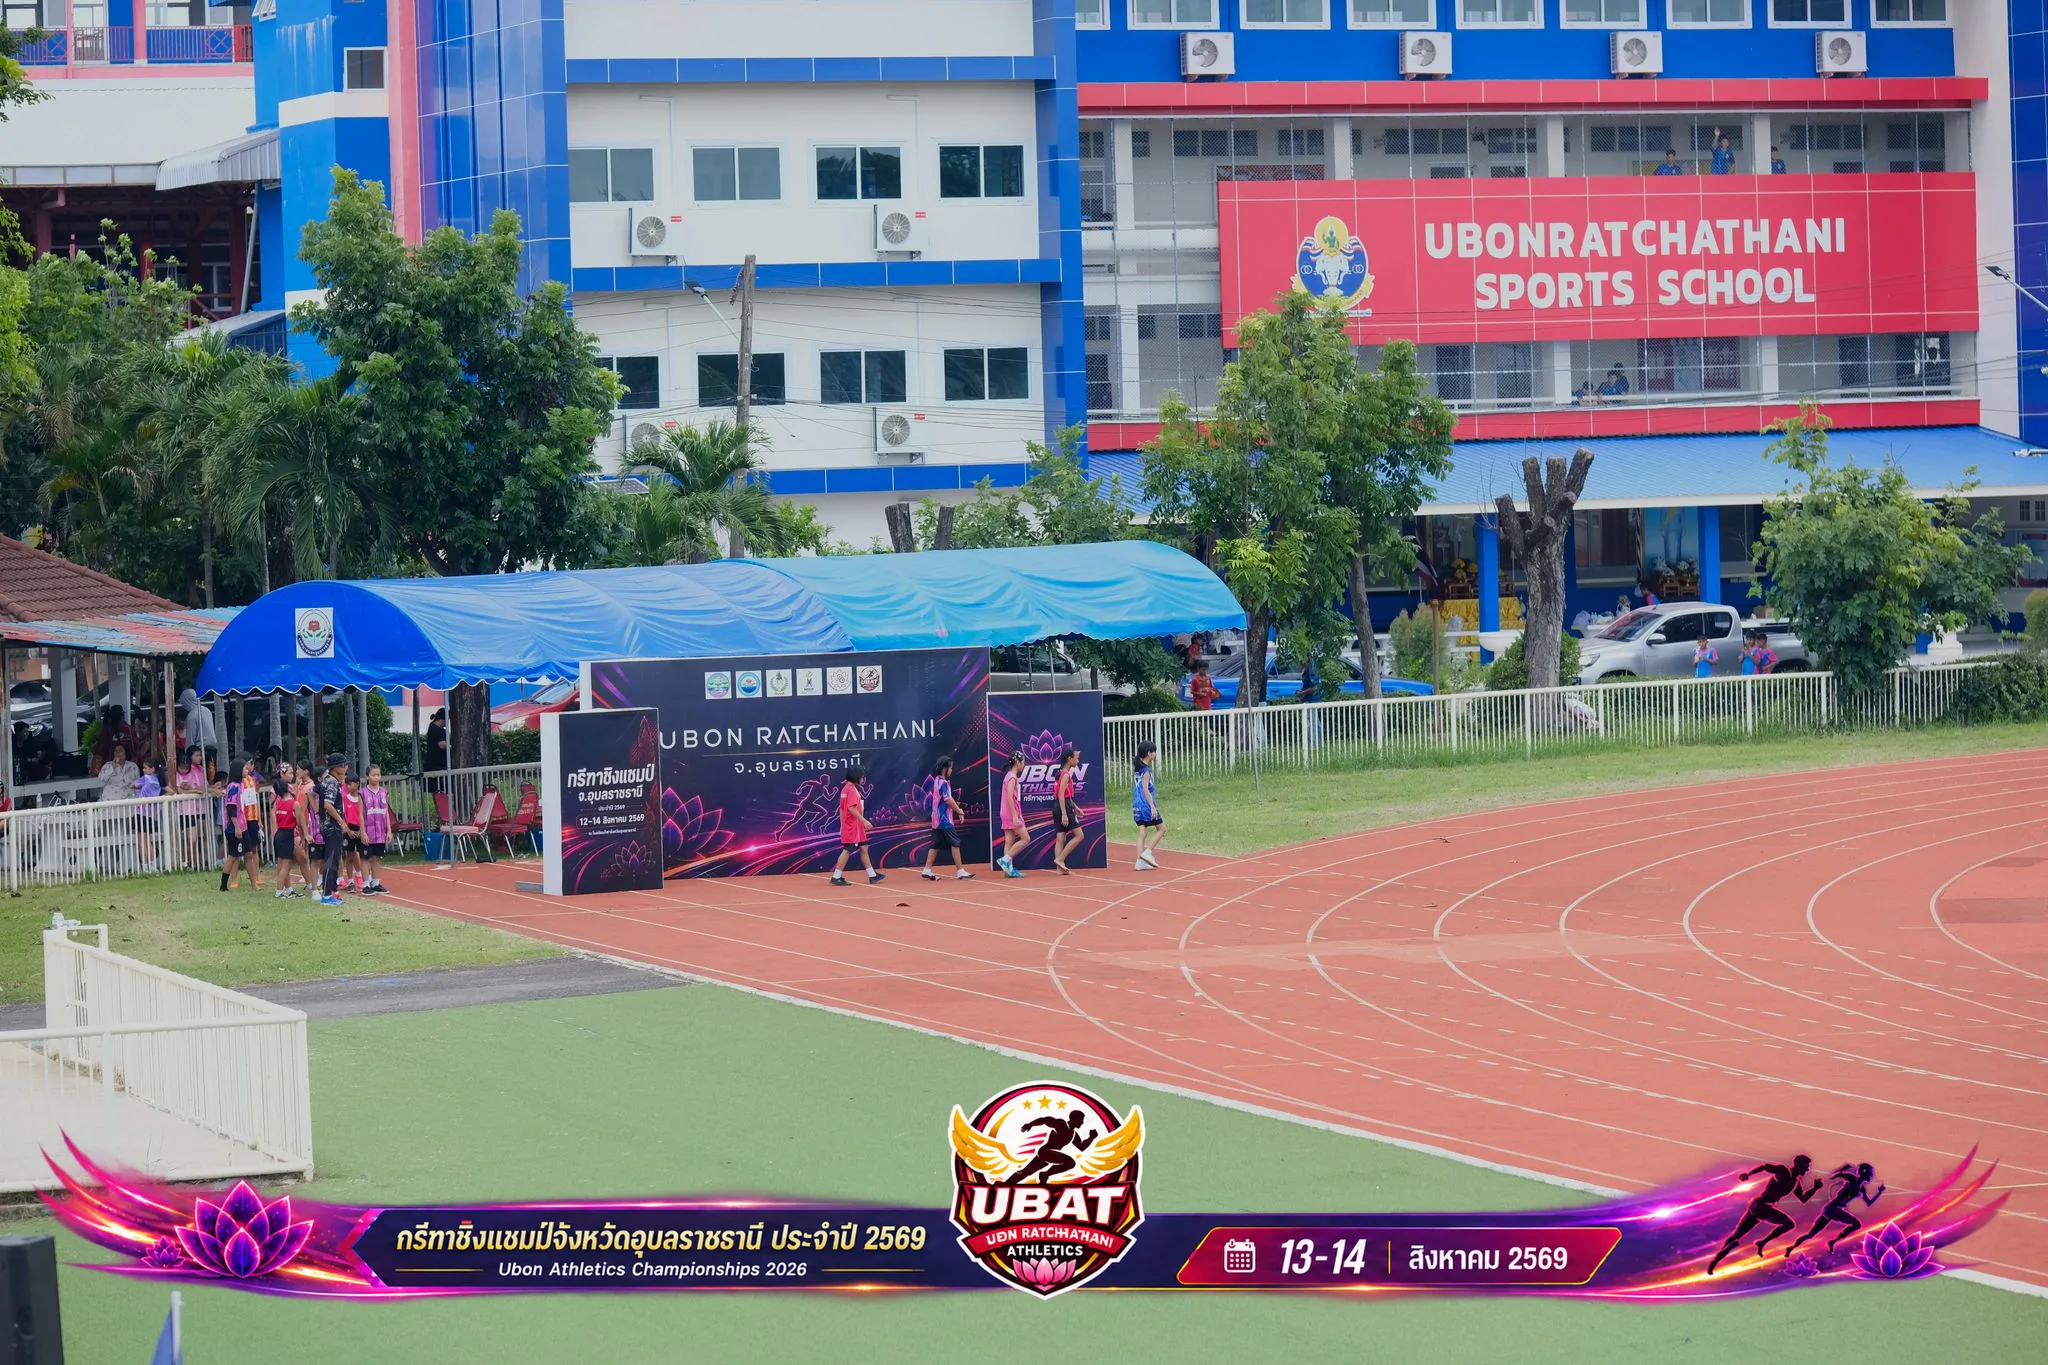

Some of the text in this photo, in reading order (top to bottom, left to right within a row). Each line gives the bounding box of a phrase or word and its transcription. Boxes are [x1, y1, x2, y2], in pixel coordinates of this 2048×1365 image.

[1424, 217, 1846, 259] UBONRATCHATHANI
[1476, 267, 1816, 310] SPORTS SCHOOL
[659, 719, 936, 750] UBON RATCHATHANI
[567, 763, 656, 788] กรีฑาชิงแชมป์
[579, 816, 601, 826] 12-14
[628, 813, 645, 823] 2569
